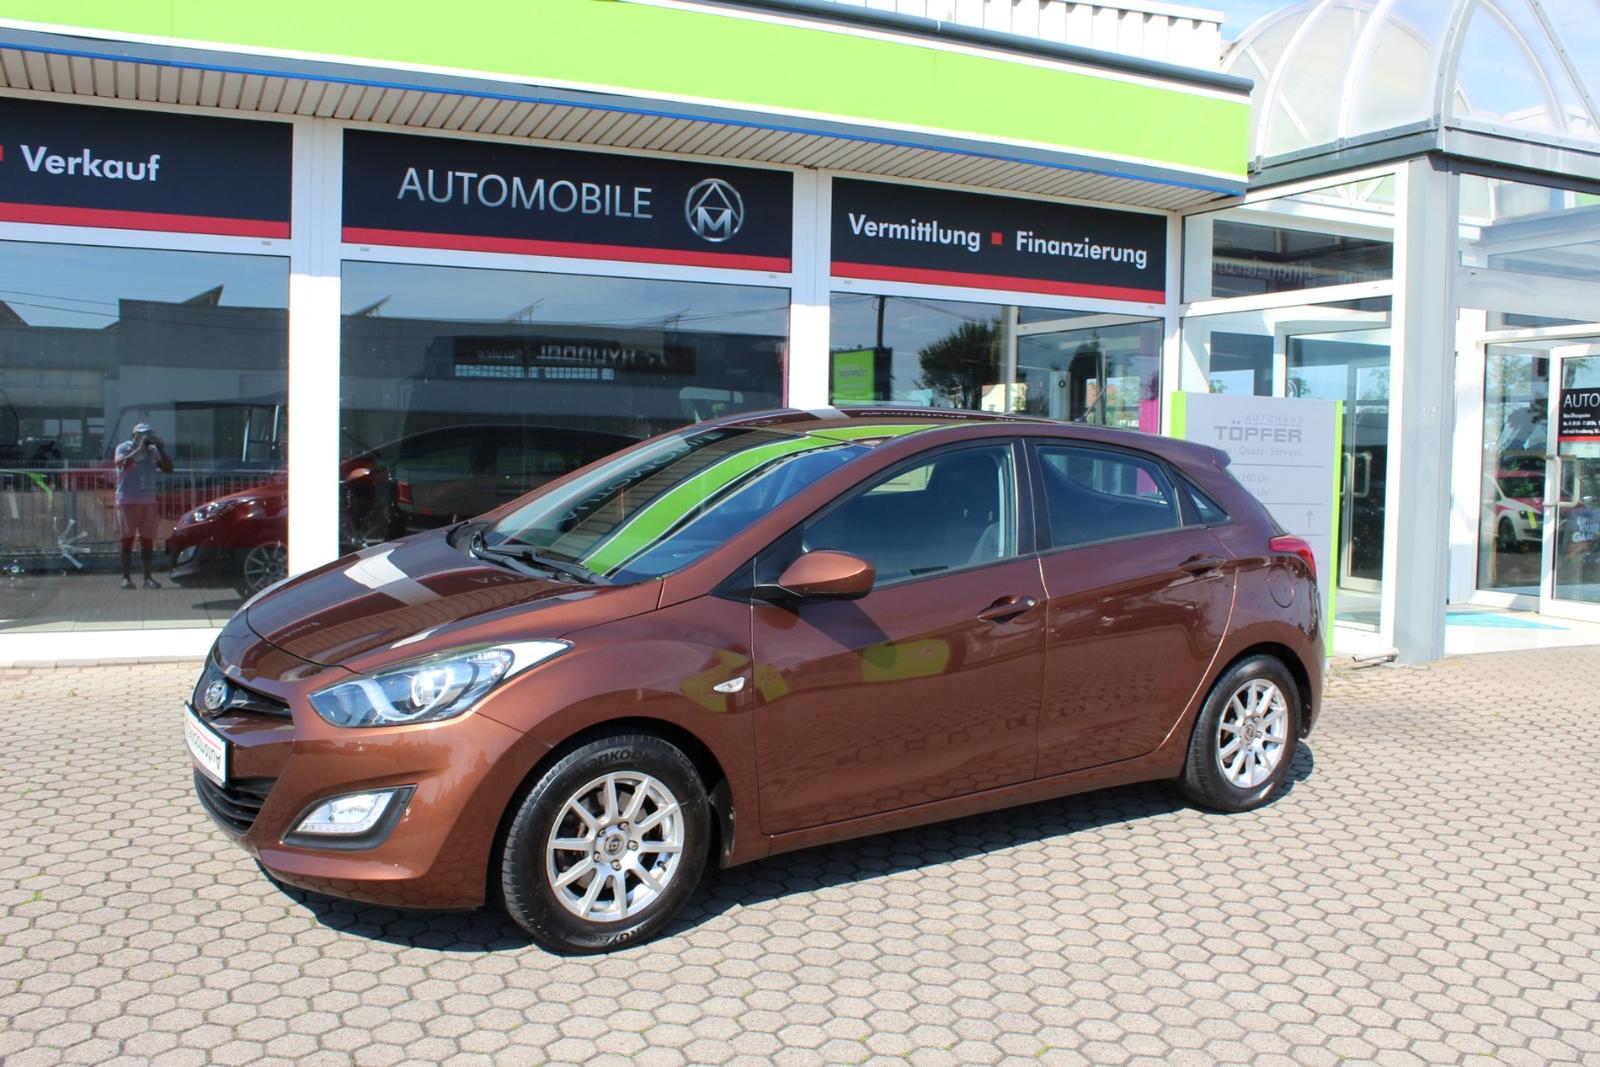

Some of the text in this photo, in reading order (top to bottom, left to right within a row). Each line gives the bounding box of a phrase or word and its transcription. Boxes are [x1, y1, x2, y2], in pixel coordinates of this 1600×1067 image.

[19, 144, 161, 182] Verkauf
[397, 167, 653, 219] AUTOMOBILE
[849, 213, 1148, 269] Vermittlung Finanzierung
[1214, 420, 1302, 443] TÖPFER
